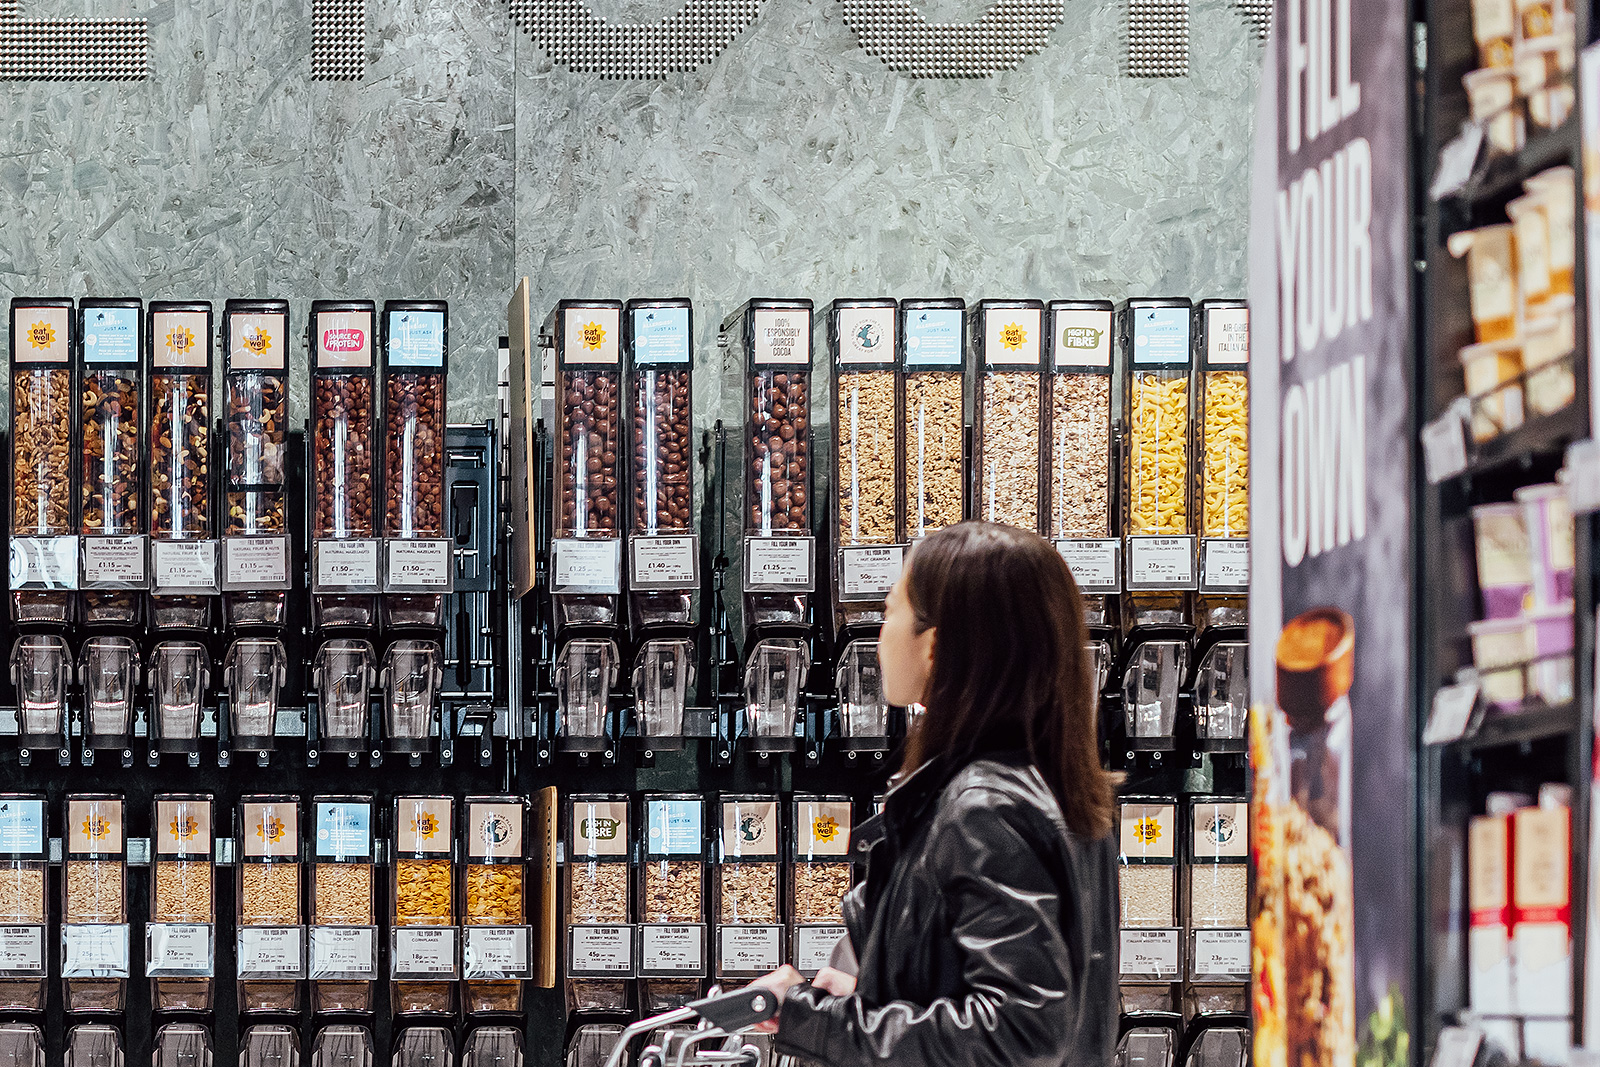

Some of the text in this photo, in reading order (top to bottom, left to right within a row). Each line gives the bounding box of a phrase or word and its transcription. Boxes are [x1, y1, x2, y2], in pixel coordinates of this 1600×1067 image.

[1285, 0, 1361, 154] FILL
[1276, 137, 1373, 361] YOUR
[1067, 329, 1095, 337] HIGH IN
[584, 334, 601, 342] well
[1067, 336, 1095, 347] FIBRE
[173, 339, 188, 347] well
[250, 339, 266, 347] well
[329, 339, 360, 348] PROTEIN
[772, 347, 792, 357] COCOA
[1281, 355, 1366, 568] OWN
[816, 826, 833, 834] well
